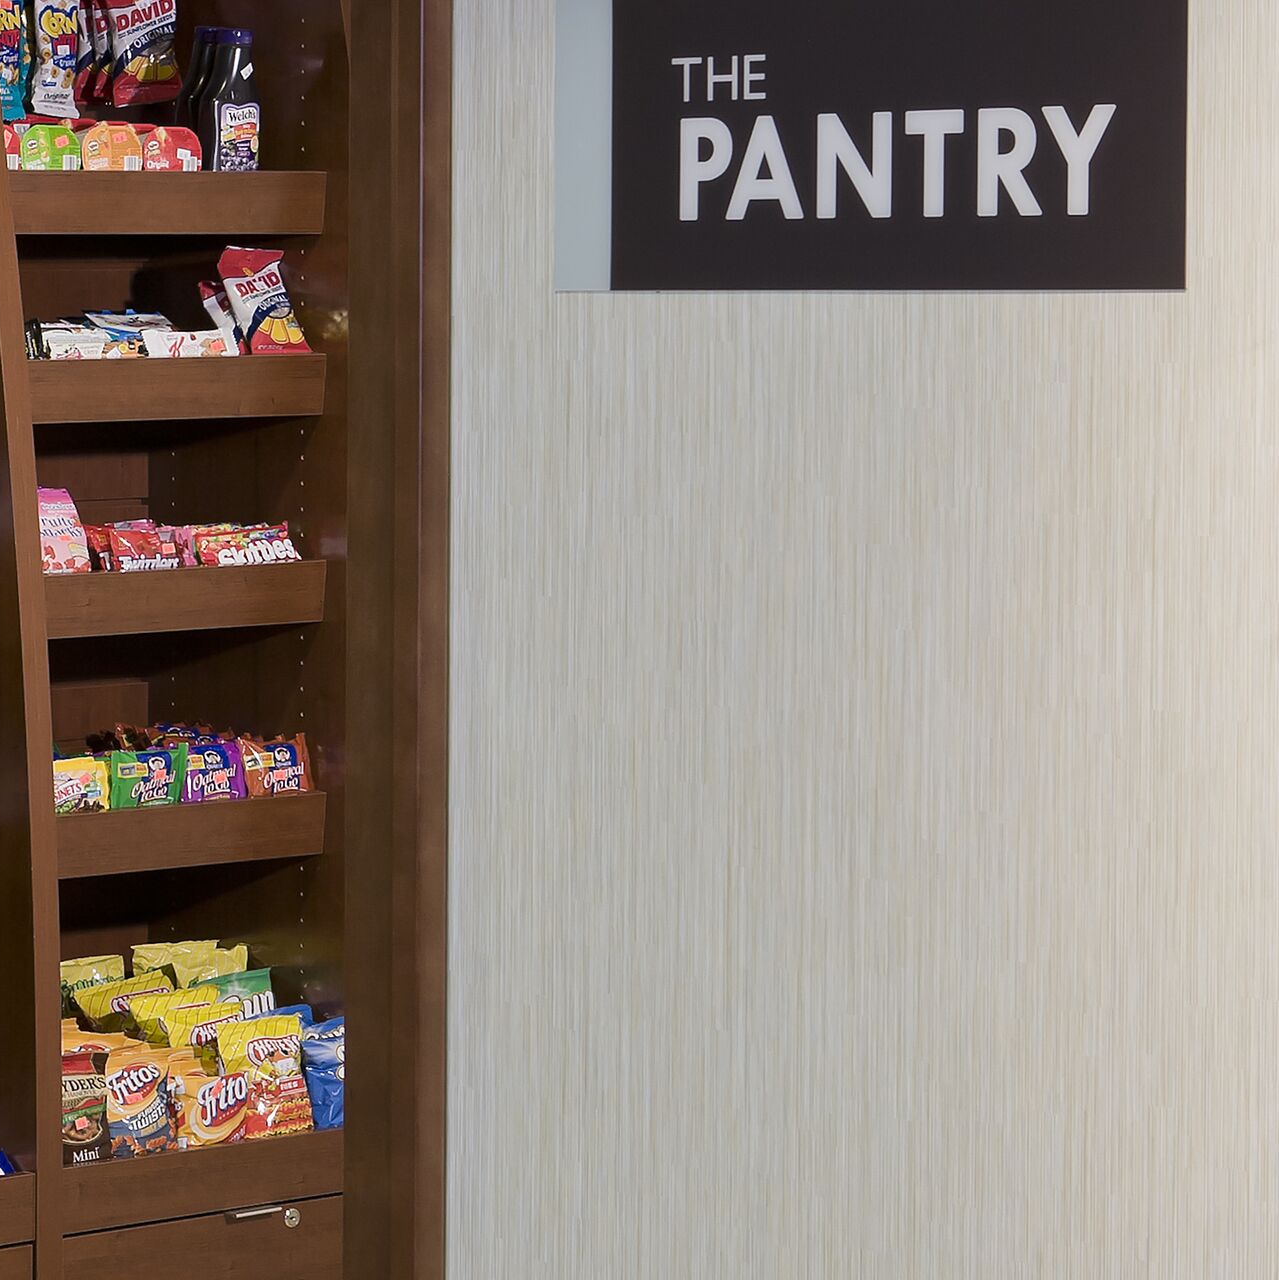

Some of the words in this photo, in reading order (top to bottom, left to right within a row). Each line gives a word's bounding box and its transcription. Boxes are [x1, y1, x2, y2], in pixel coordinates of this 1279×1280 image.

[132, 24, 175, 49] ORIGINAL
[671, 53, 767, 103] THE
[228, 109, 256, 122] Welch's
[678, 103, 1118, 222] PANTRY
[217, 538, 297, 566] Skittles
[62, 1075, 107, 1093] YDER'S
[105, 1061, 161, 1106] Fritos
[197, 1071, 249, 1127] Frito
